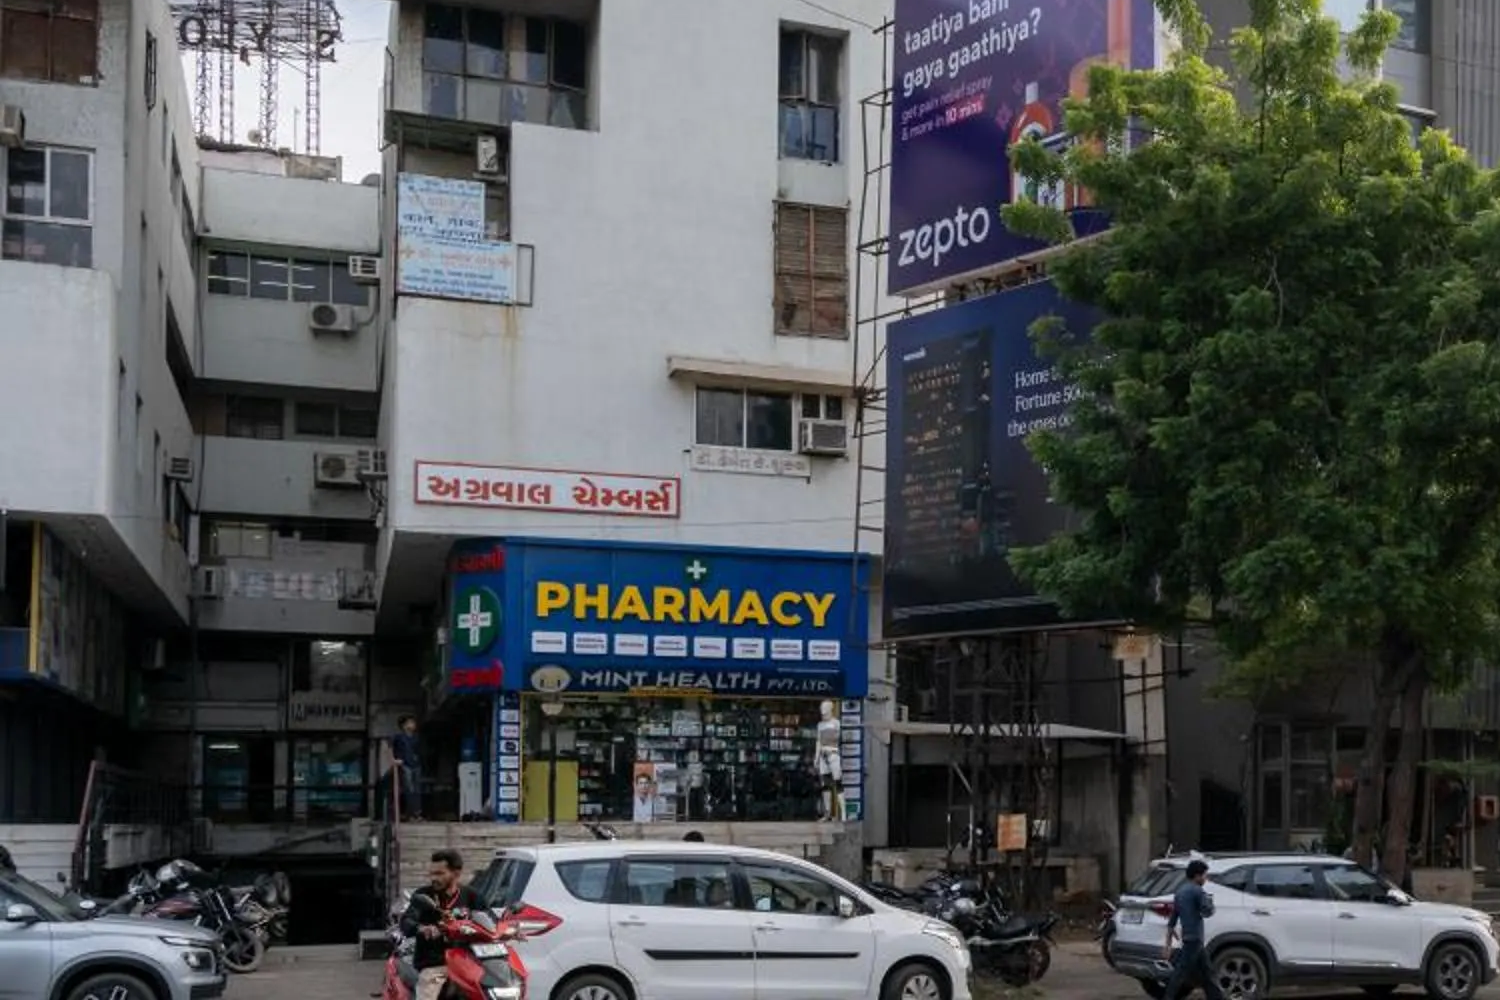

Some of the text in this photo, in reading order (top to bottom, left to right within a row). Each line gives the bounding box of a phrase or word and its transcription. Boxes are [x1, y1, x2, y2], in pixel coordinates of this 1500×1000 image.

[904, 12, 964, 55] taatiya
[903, 7, 1042, 97] gaya gaathiya?
[945, 107, 957, 125] 10
[898, 205, 990, 267] zepto
[1015, 369, 1049, 389] Home
[1015, 391, 1061, 413] Fortune
[1007, 419, 1027, 437] the
[427, 475, 553, 505] અગ્રવાલ
[536, 580, 837, 628] PHARMACY
[580, 670, 649, 687] MINT
[656, 671, 762, 690] HEALTH
